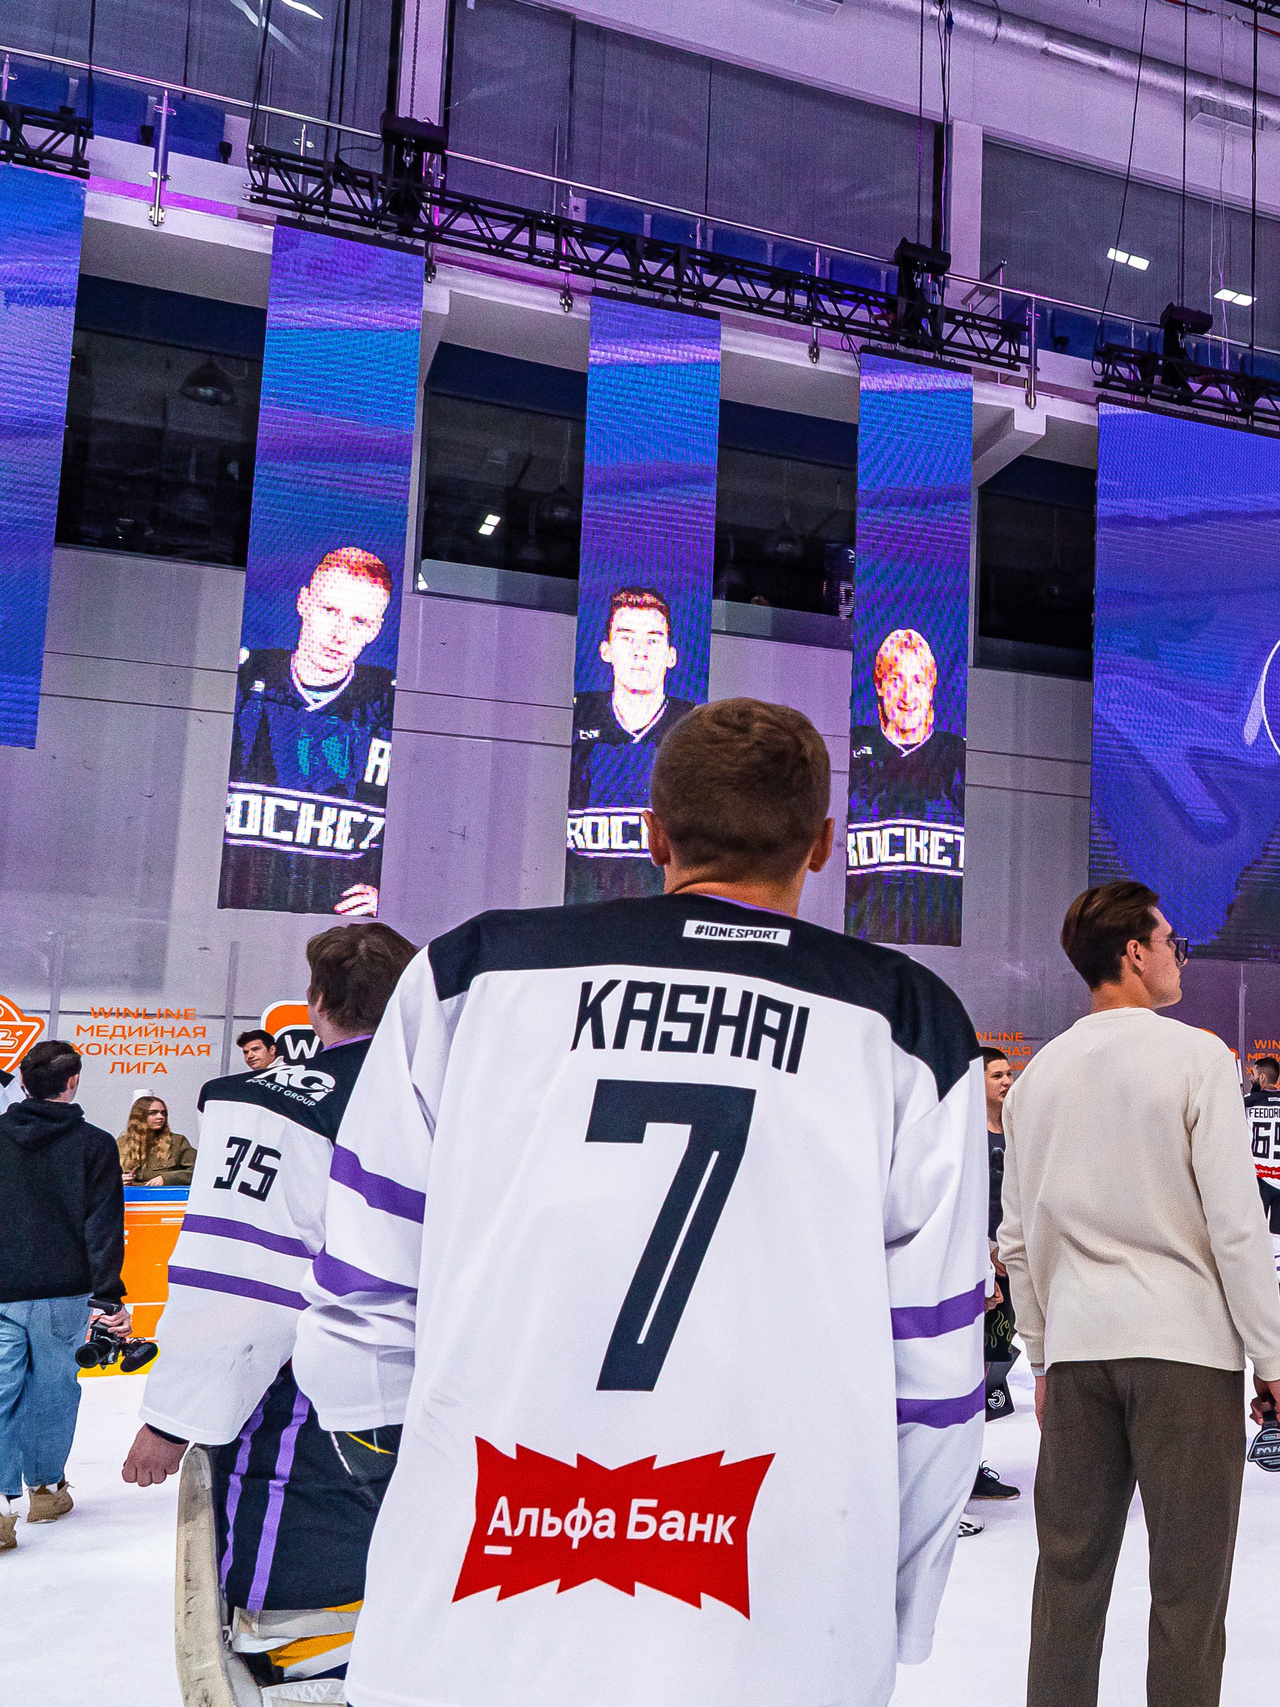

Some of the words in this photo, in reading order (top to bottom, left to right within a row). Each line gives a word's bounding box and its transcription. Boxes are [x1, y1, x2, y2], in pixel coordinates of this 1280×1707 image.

[90, 1006, 197, 1021] WINLINE
[75, 1022, 207, 1041] МЕДИЙНАЯ
[570, 978, 810, 1074] KASHAI
[976, 1031, 1025, 1042] NLINE
[71, 1040, 211, 1057] ХОККЕЙНАЯ
[109, 1061, 168, 1075] ЛИГА
[284, 1090, 317, 1108] GROUP
[213, 1136, 282, 1202] 35
[585, 1078, 757, 1391] 7
[486, 1496, 616, 1550] Альфа
[626, 1498, 737, 1546] Банк
